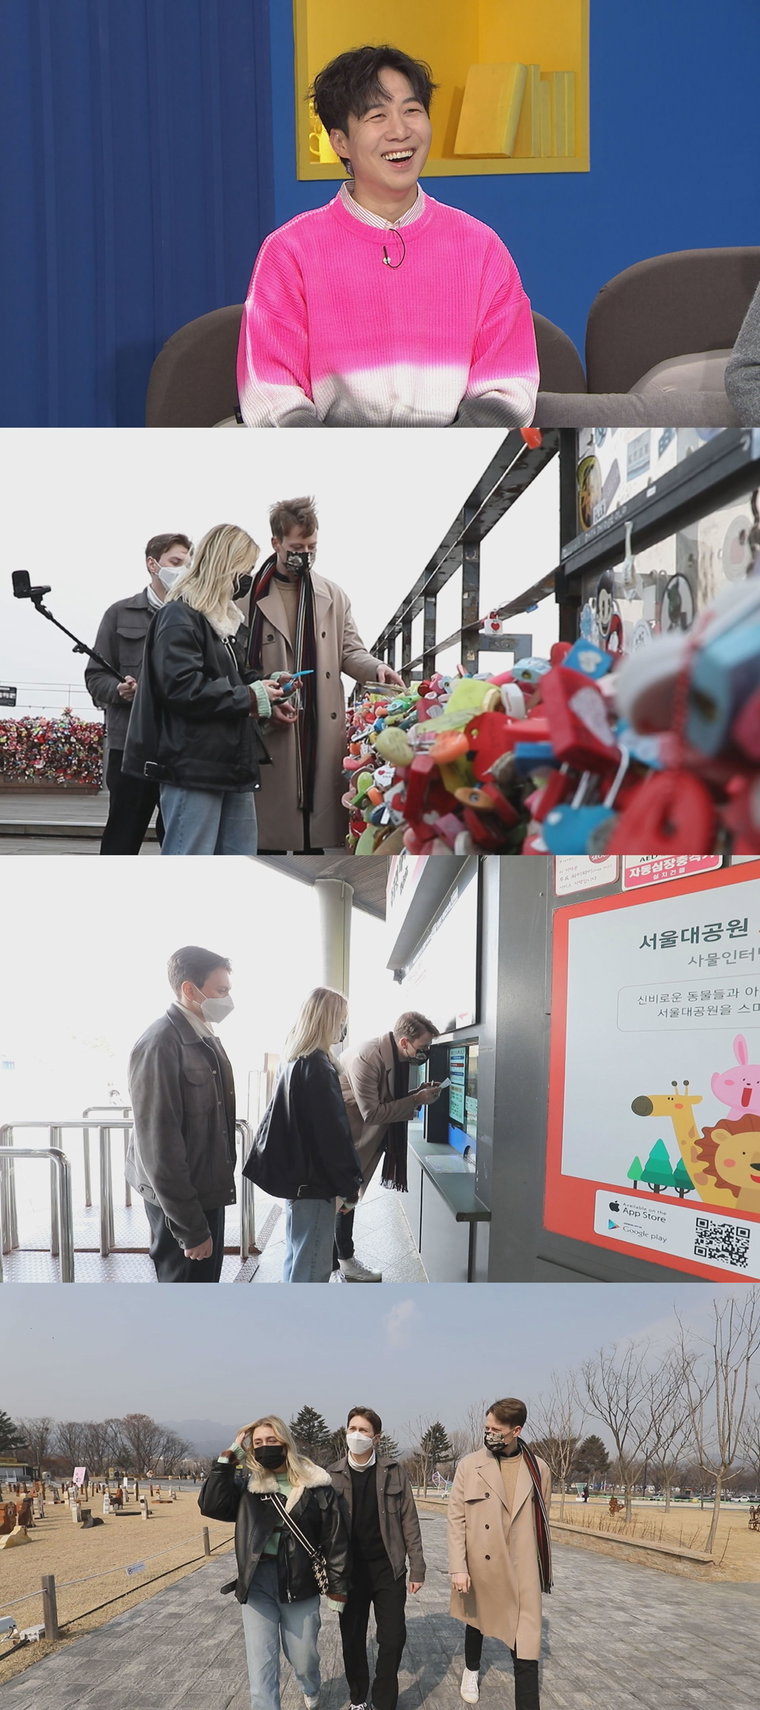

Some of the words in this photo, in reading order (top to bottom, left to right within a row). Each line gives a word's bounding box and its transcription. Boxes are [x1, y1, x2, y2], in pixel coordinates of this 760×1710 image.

[639, 917, 749, 950] 서울대공원
[688, 947, 760, 968] 사물인터
[637, 992, 682, 1006] 신비로운
[687, 987, 740, 1002] 동물들과
[657, 1004, 732, 1018] 서울대공원을
[622, 1207, 641, 1218] App
[643, 1211, 666, 1223] Store
[623, 1226, 649, 1237] Google
[651, 1234, 667, 1243] play
